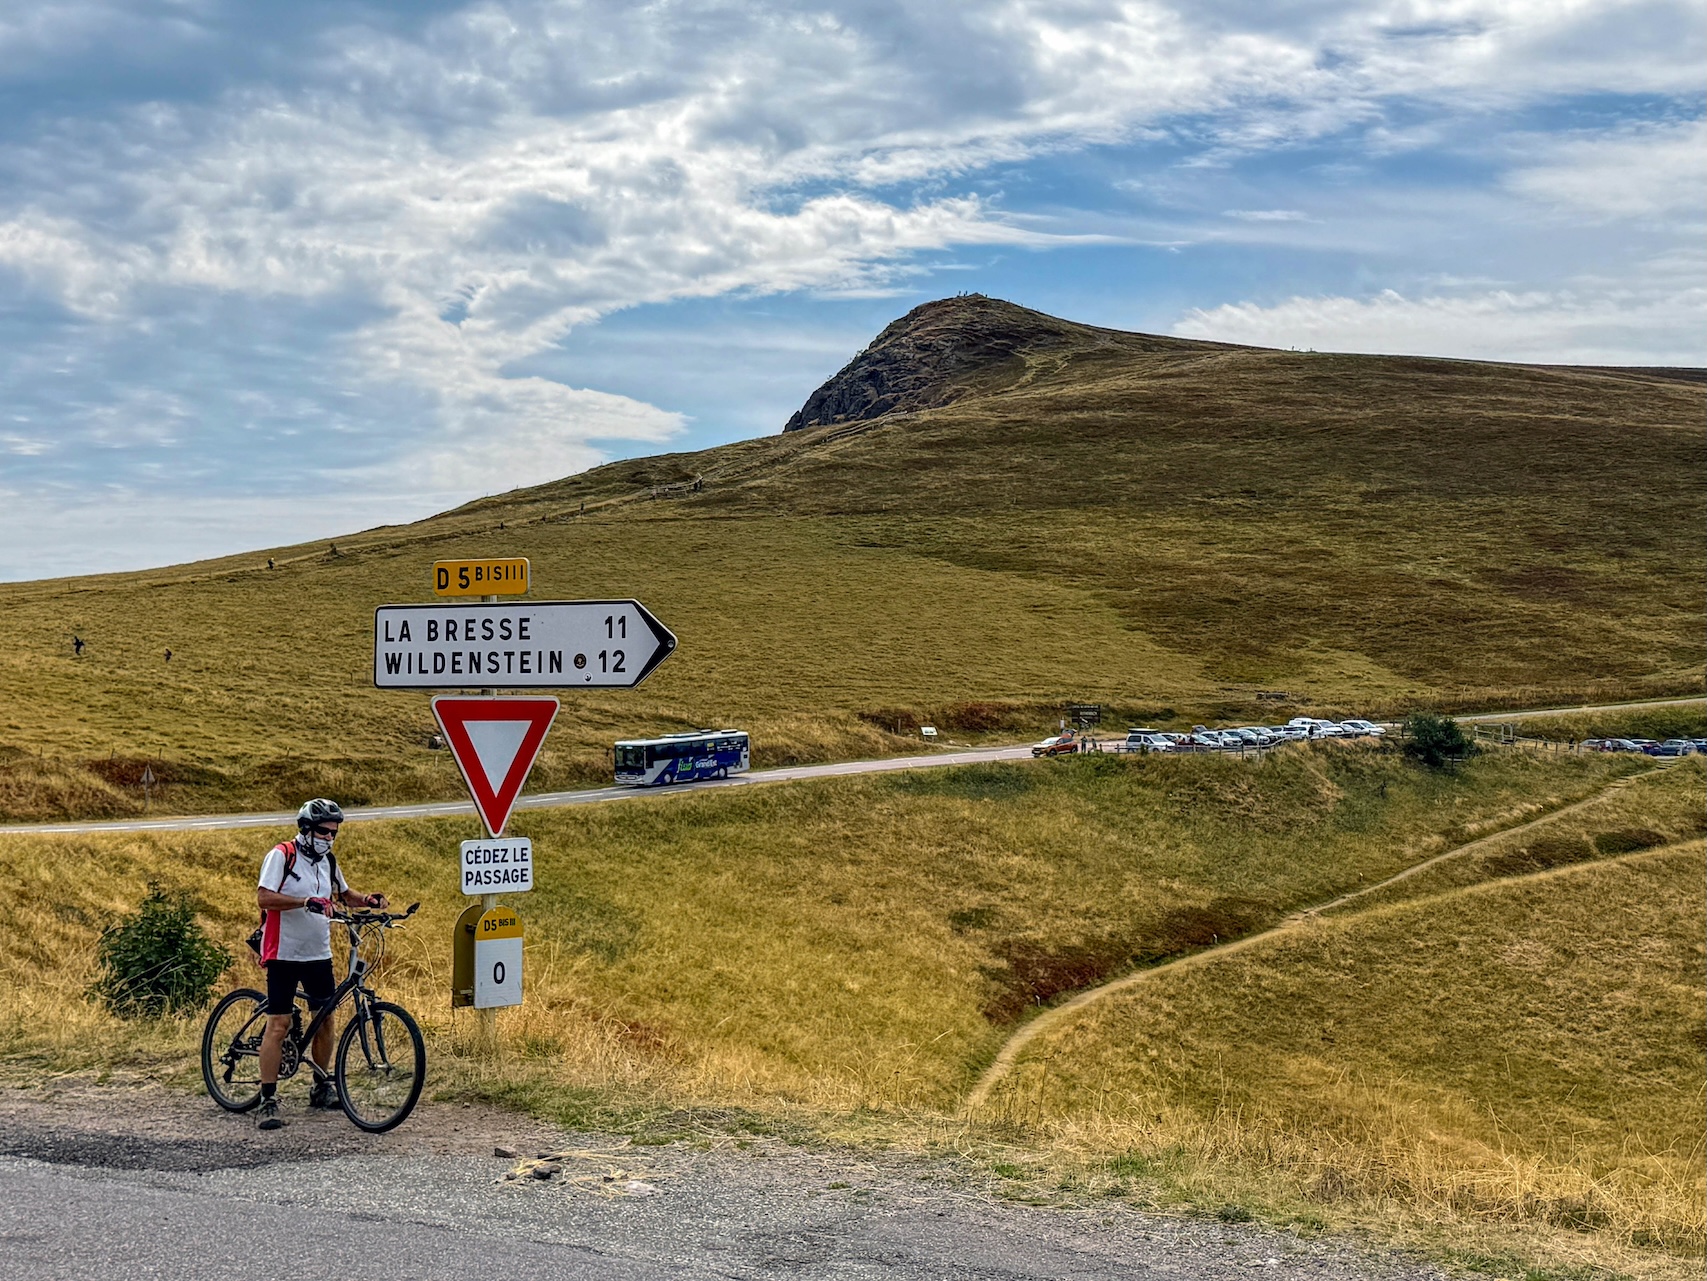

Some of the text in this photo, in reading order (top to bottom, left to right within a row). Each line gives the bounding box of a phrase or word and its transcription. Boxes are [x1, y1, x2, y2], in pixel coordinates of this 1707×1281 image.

[437, 567, 449, 590] D
[384, 615, 627, 642] LA BRESSE 11
[385, 650, 626, 674] WILDENSTEIN 12
[465, 846, 529, 865] CÉDEZ LE
[465, 868, 529, 886] PASSAGE
[493, 961, 505, 985] 0
